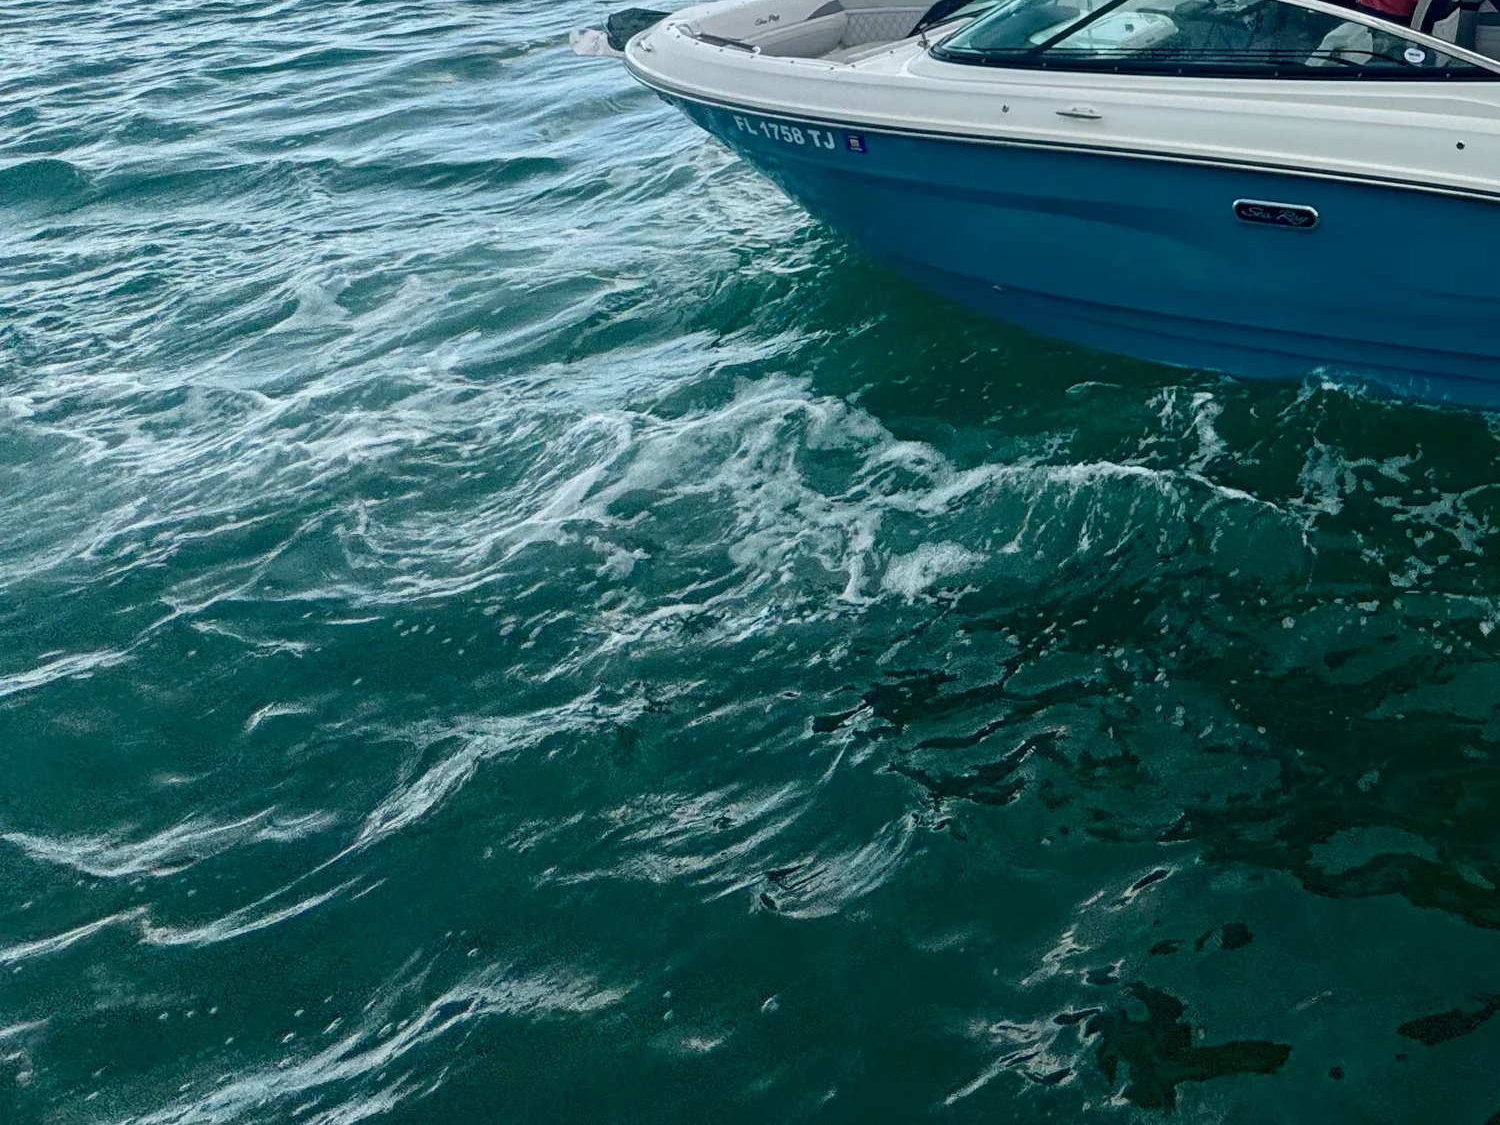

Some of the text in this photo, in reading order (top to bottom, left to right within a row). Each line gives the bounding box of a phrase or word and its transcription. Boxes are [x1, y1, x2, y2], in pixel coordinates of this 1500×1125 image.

[733, 115, 758, 136] FL
[760, 121, 805, 145] 1758
[807, 129, 836, 150] TJ
